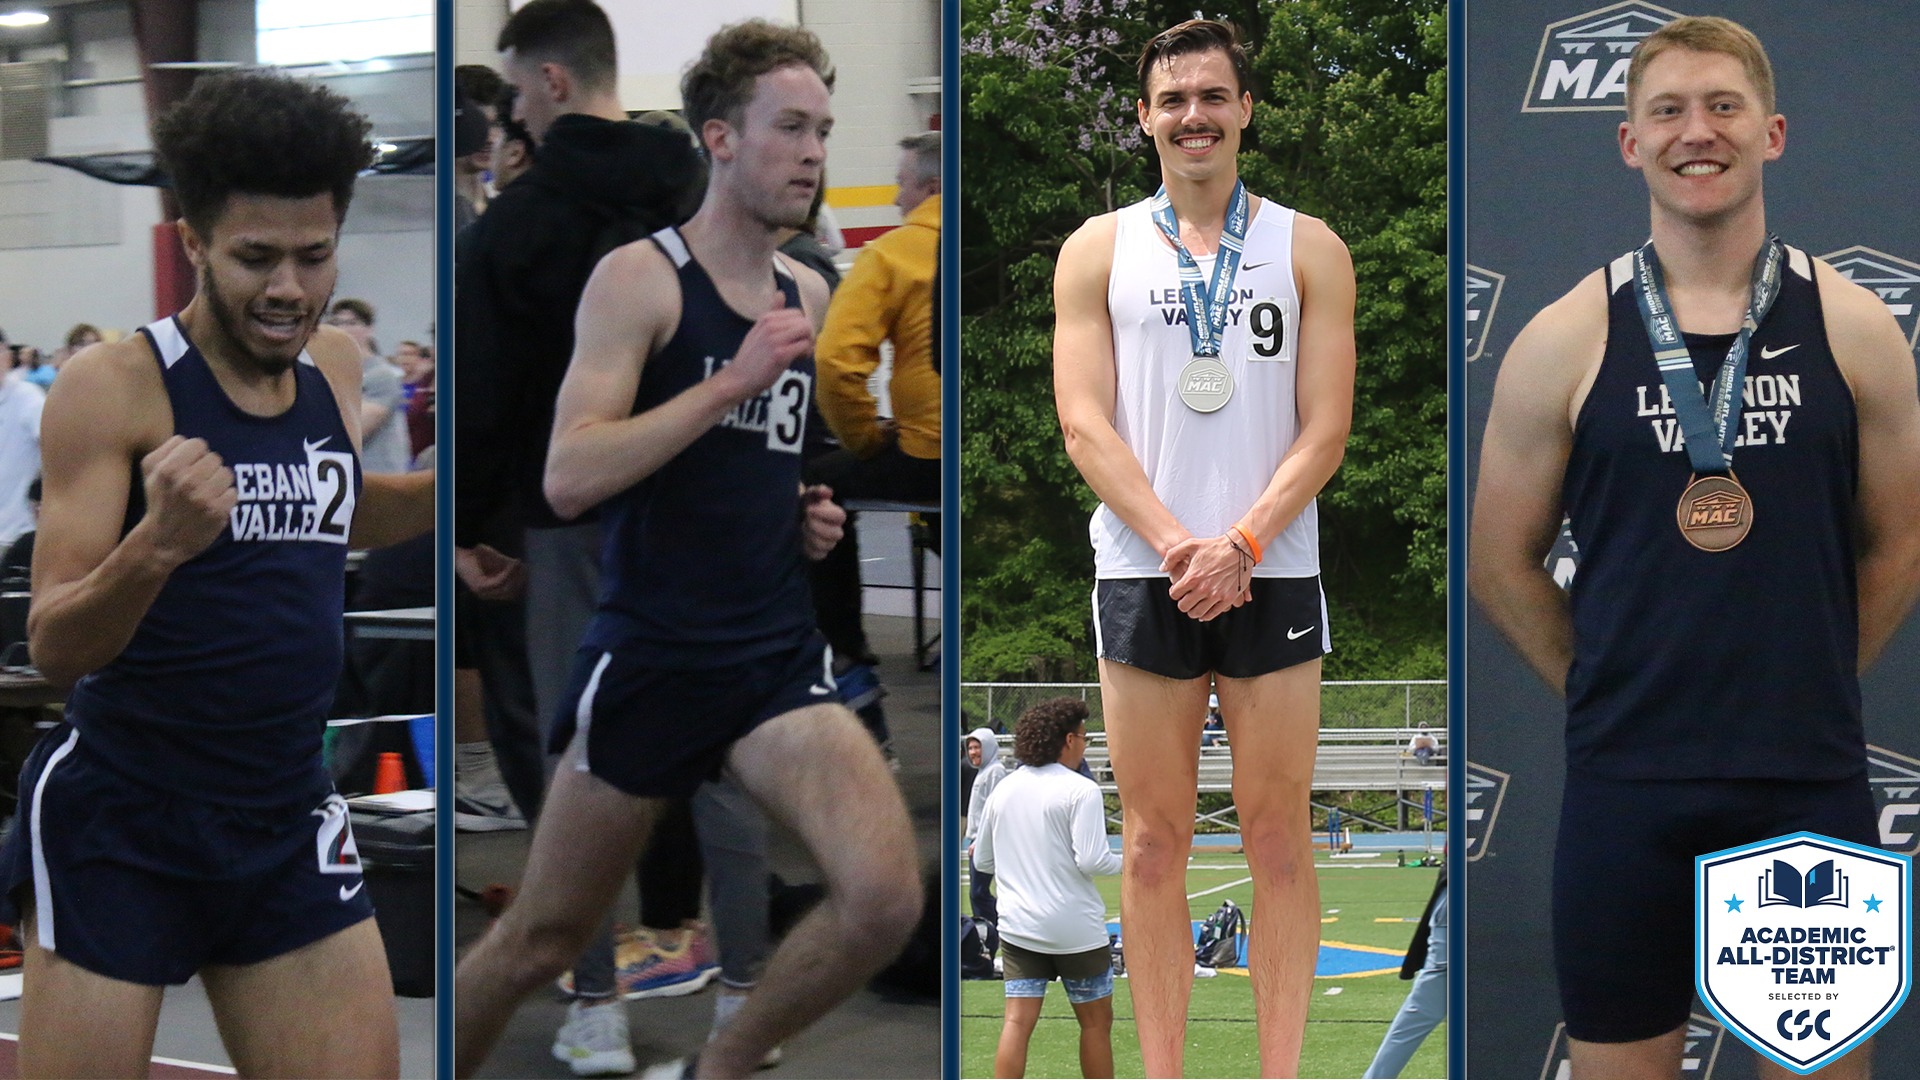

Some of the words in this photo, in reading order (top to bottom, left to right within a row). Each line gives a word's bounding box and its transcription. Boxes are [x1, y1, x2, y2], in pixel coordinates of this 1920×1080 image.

[1540, 59, 1633, 100] MA
[1637, 250, 1649, 284] ATLANTIC
[1149, 288, 1254, 306] LEON
[1643, 285, 1658, 315] MIDDLE
[1645, 263, 1665, 313] CONFERENCE
[1161, 308, 1243, 326] VAY
[1250, 302, 1284, 357] 9
[1657, 315, 1676, 342] MAC
[1187, 380, 1223, 392] MAC
[1636, 374, 1801, 416] LENON
[1713, 364, 1728, 423] CONFERENCE
[1724, 366, 1736, 401] MIDDLE
[776, 378, 805, 445] 3
[1651, 411, 1792, 453] VAEY
[233, 463, 312, 501] EBAN
[317, 458, 348, 537] 2
[229, 503, 318, 542] VALLE
[1690, 508, 1739, 526] MAC
